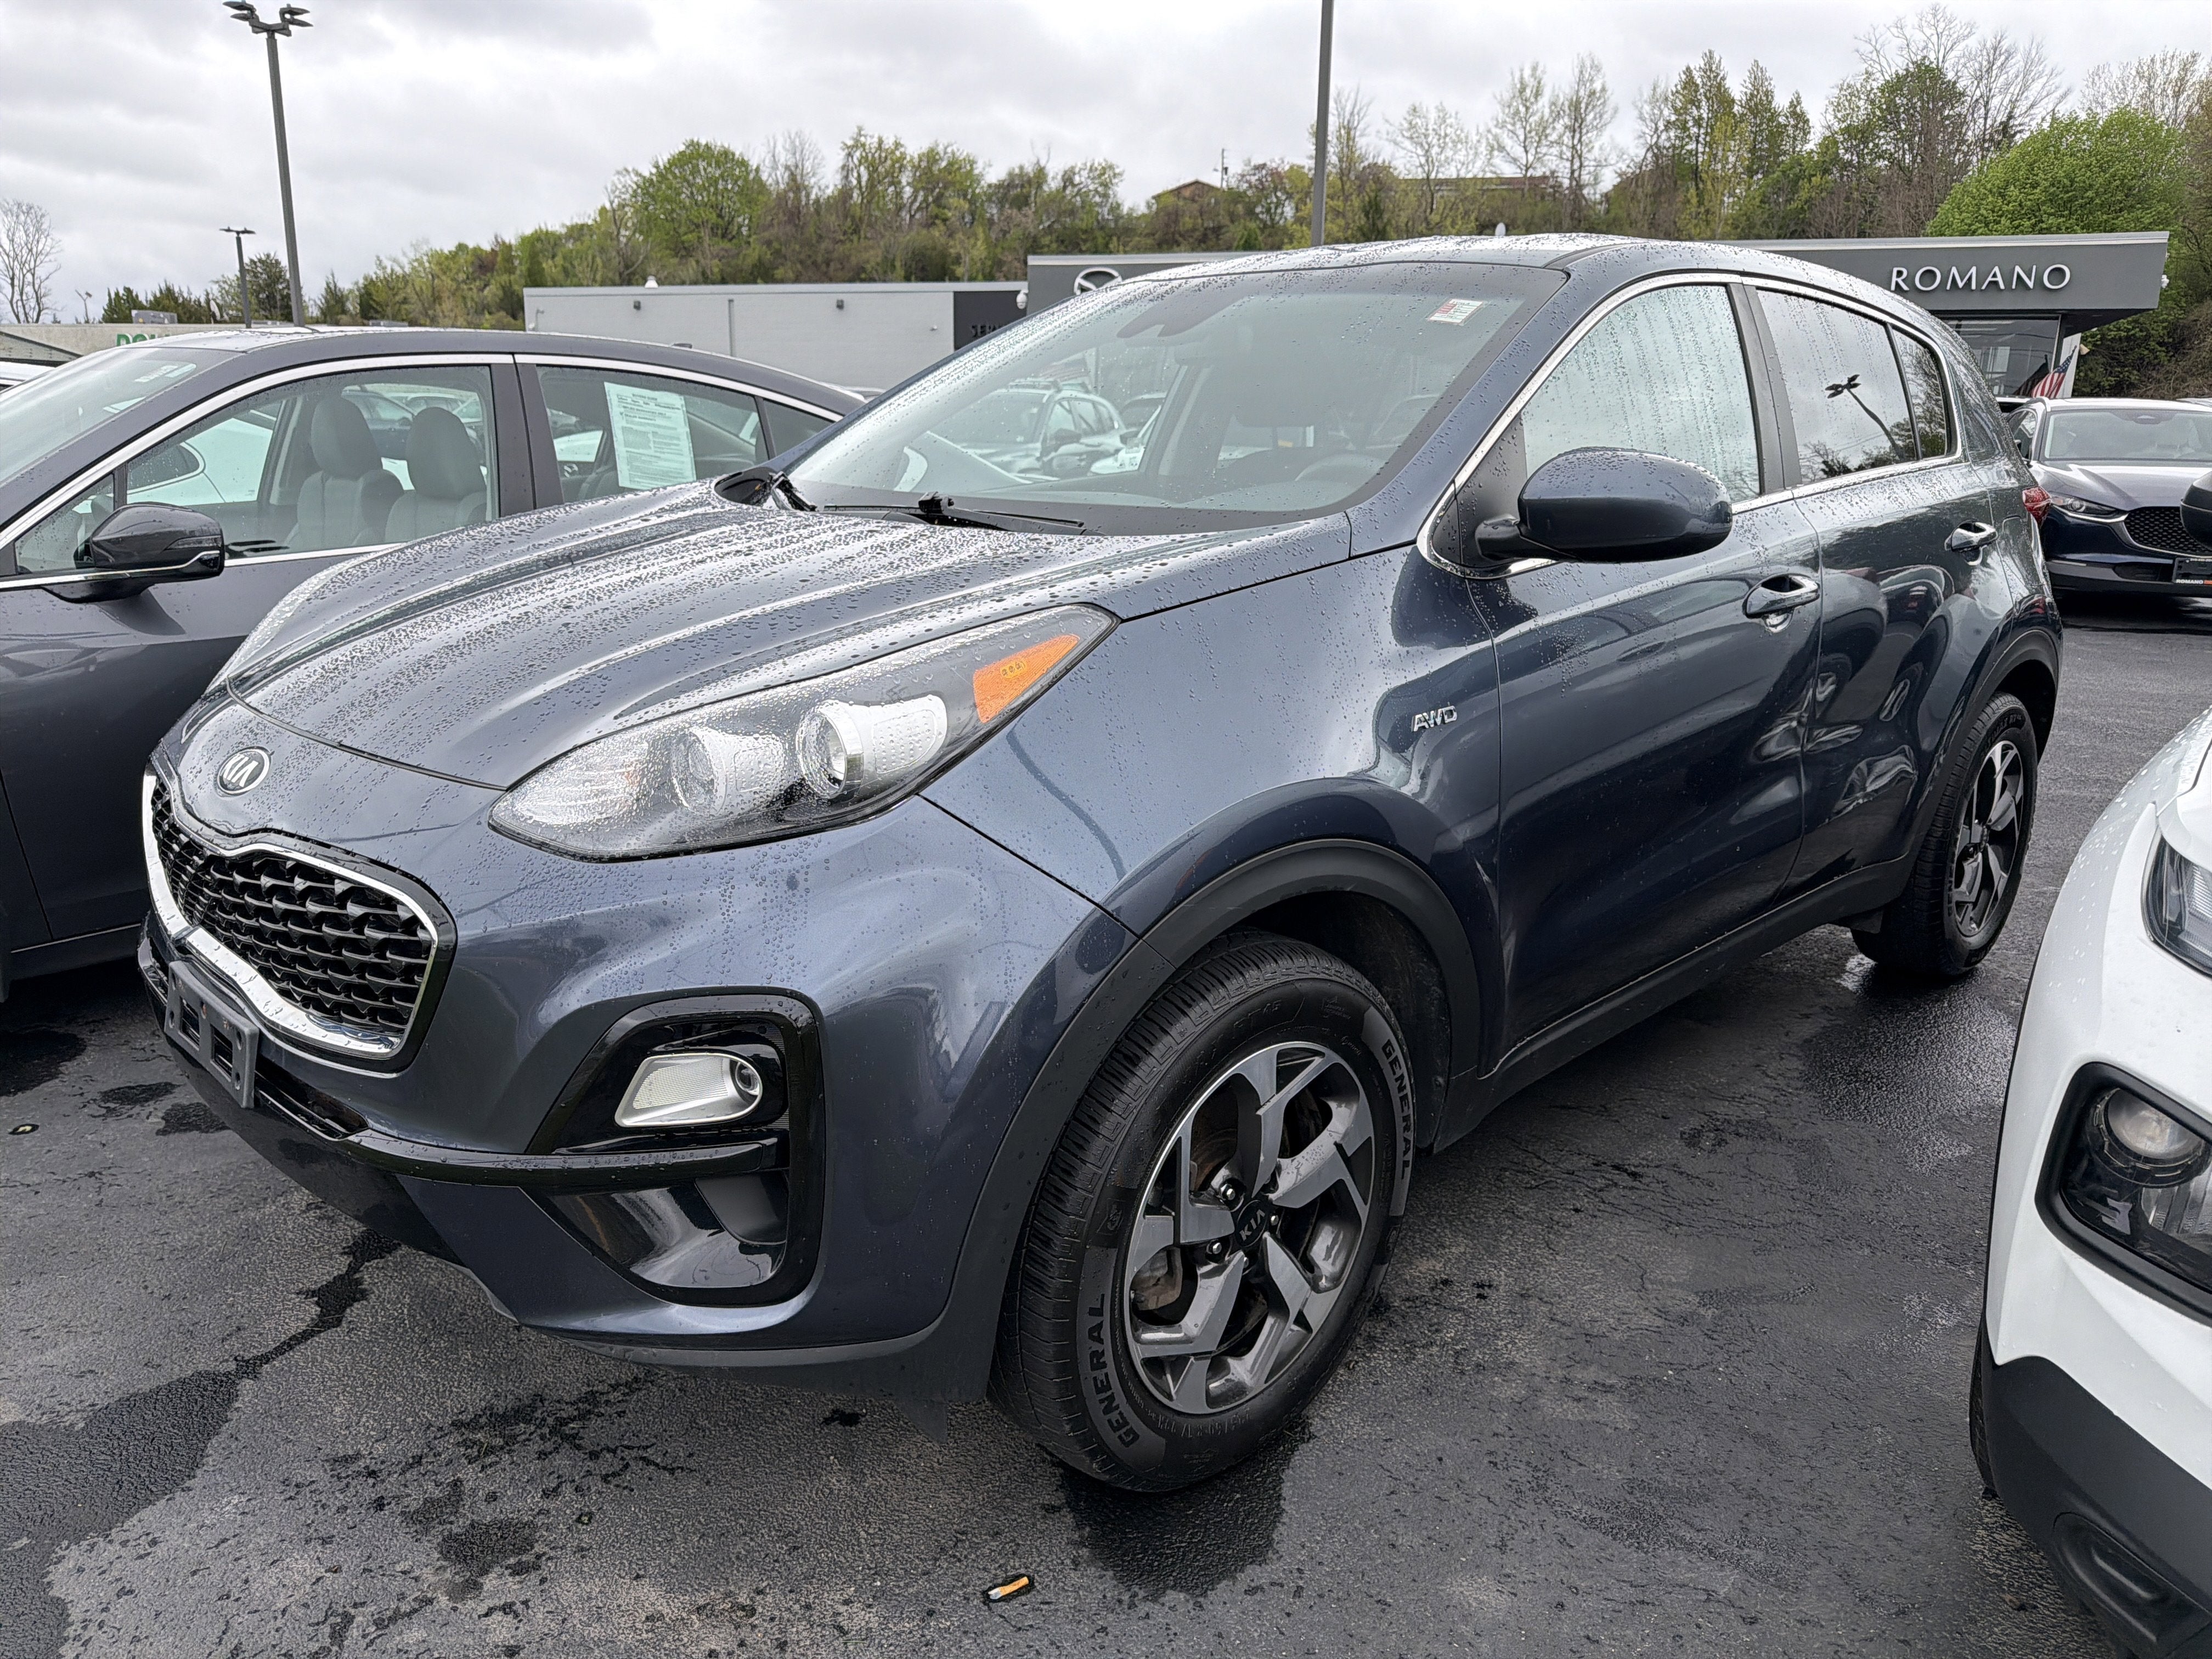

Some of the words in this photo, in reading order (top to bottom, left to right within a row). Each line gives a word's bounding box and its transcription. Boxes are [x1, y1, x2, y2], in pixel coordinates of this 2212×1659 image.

[1891, 264, 2071, 291] ROMANO
[1411, 706, 1457, 732] AWD
[1381, 1039, 1413, 1180] GENERAL
[1239, 1209, 1266, 1241] KIA
[1088, 1293, 1140, 1448] GENERAL
